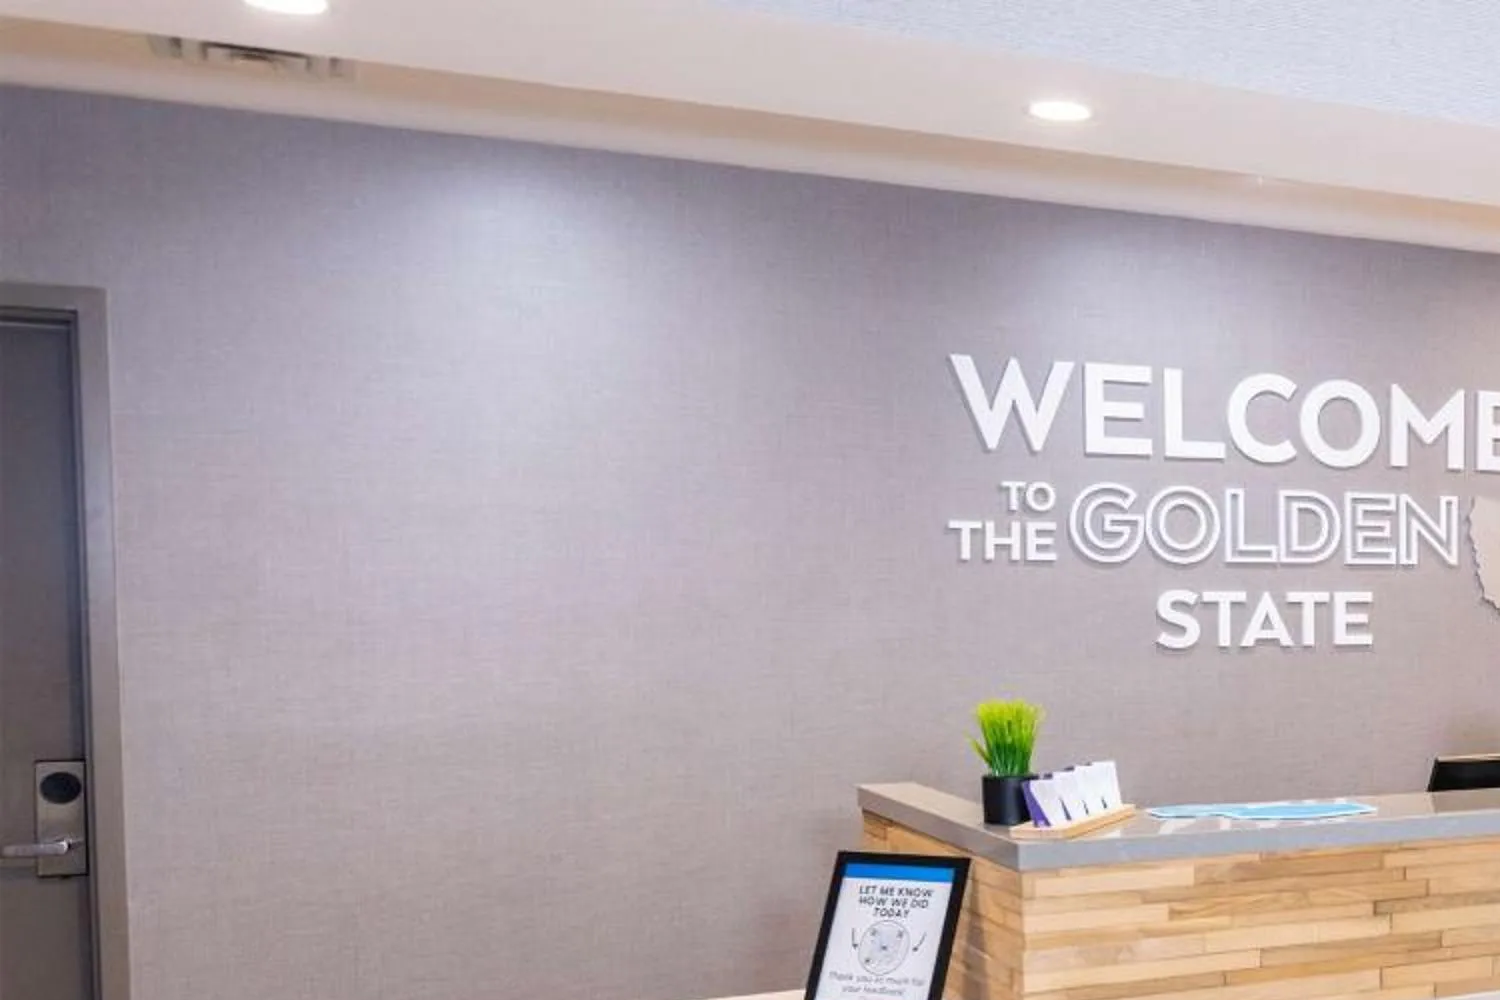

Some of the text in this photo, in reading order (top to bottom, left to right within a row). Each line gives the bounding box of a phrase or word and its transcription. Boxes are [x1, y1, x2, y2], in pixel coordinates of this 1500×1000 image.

[1001, 481, 1057, 511] TO
[948, 482, 1459, 566] THE GOLDEN
[1156, 589, 1373, 650] STATE
[859, 885, 934, 898] LET ME KNOW
[859, 896, 928, 909] HOW WE DID
[873, 907, 910, 918] TODAY
